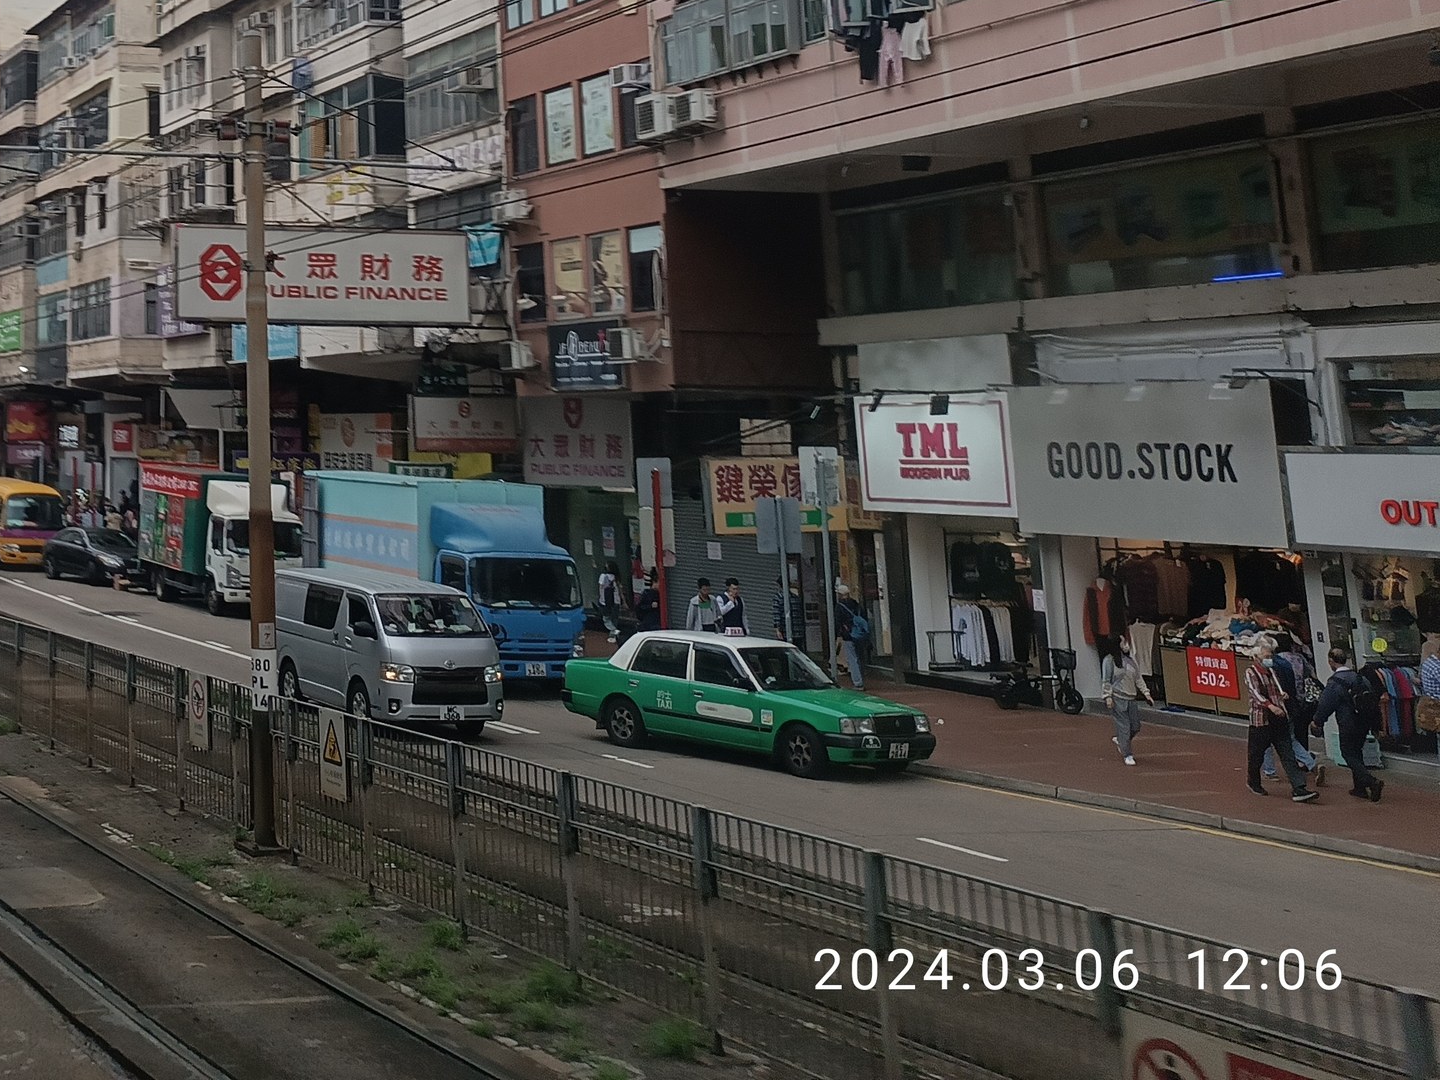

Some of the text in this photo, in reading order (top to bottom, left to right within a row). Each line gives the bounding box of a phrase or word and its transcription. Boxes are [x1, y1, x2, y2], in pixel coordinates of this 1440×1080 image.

[265, 285, 448, 301] UBLIC FINANCE
[529, 434, 624, 460] 大眾財務
[896, 423, 968, 458] TML
[530, 463, 626, 479] PUBLIC FINANCE
[1047, 442, 1238, 483] GOOD.STOCK
[1380, 499, 1439, 528] OUT
[656, 698, 673, 710] TAXI
